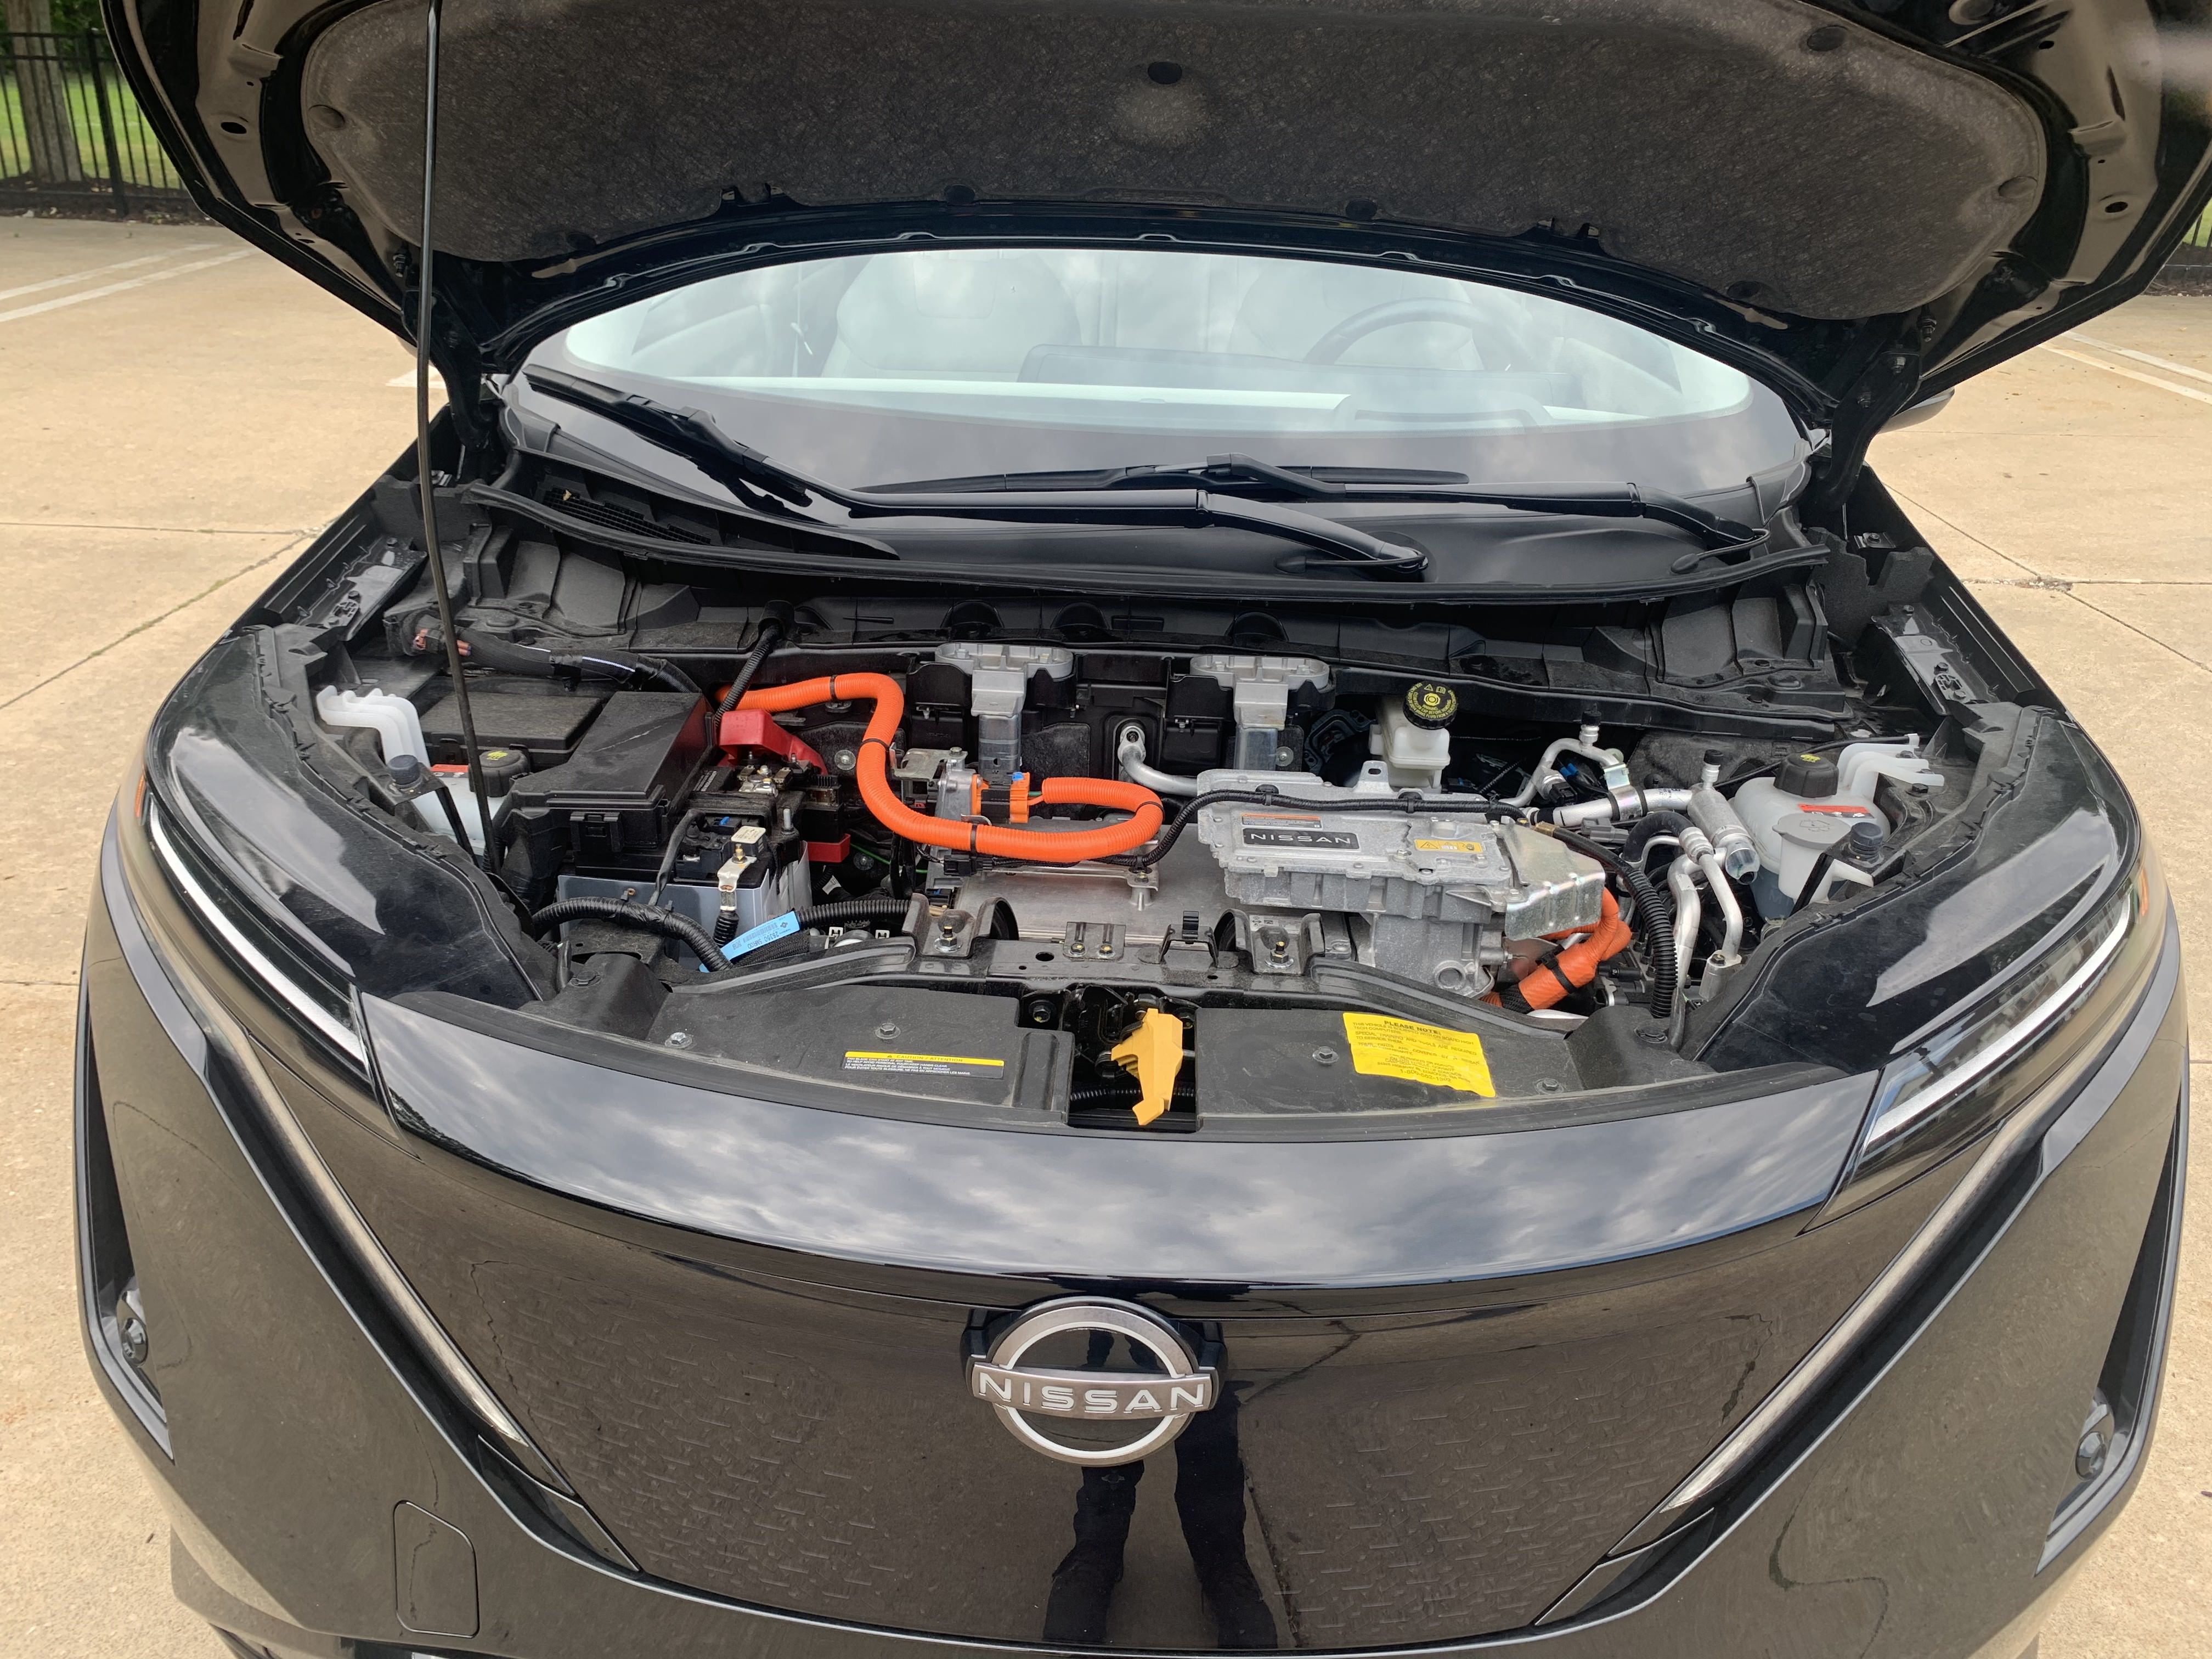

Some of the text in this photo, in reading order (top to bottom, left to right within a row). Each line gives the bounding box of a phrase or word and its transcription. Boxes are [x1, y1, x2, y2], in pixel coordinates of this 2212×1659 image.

[1251, 833, 1351, 844] NISSAN
[1384, 1020, 1414, 1029] PLEASE
[979, 1372, 1204, 1413] NISSAN
